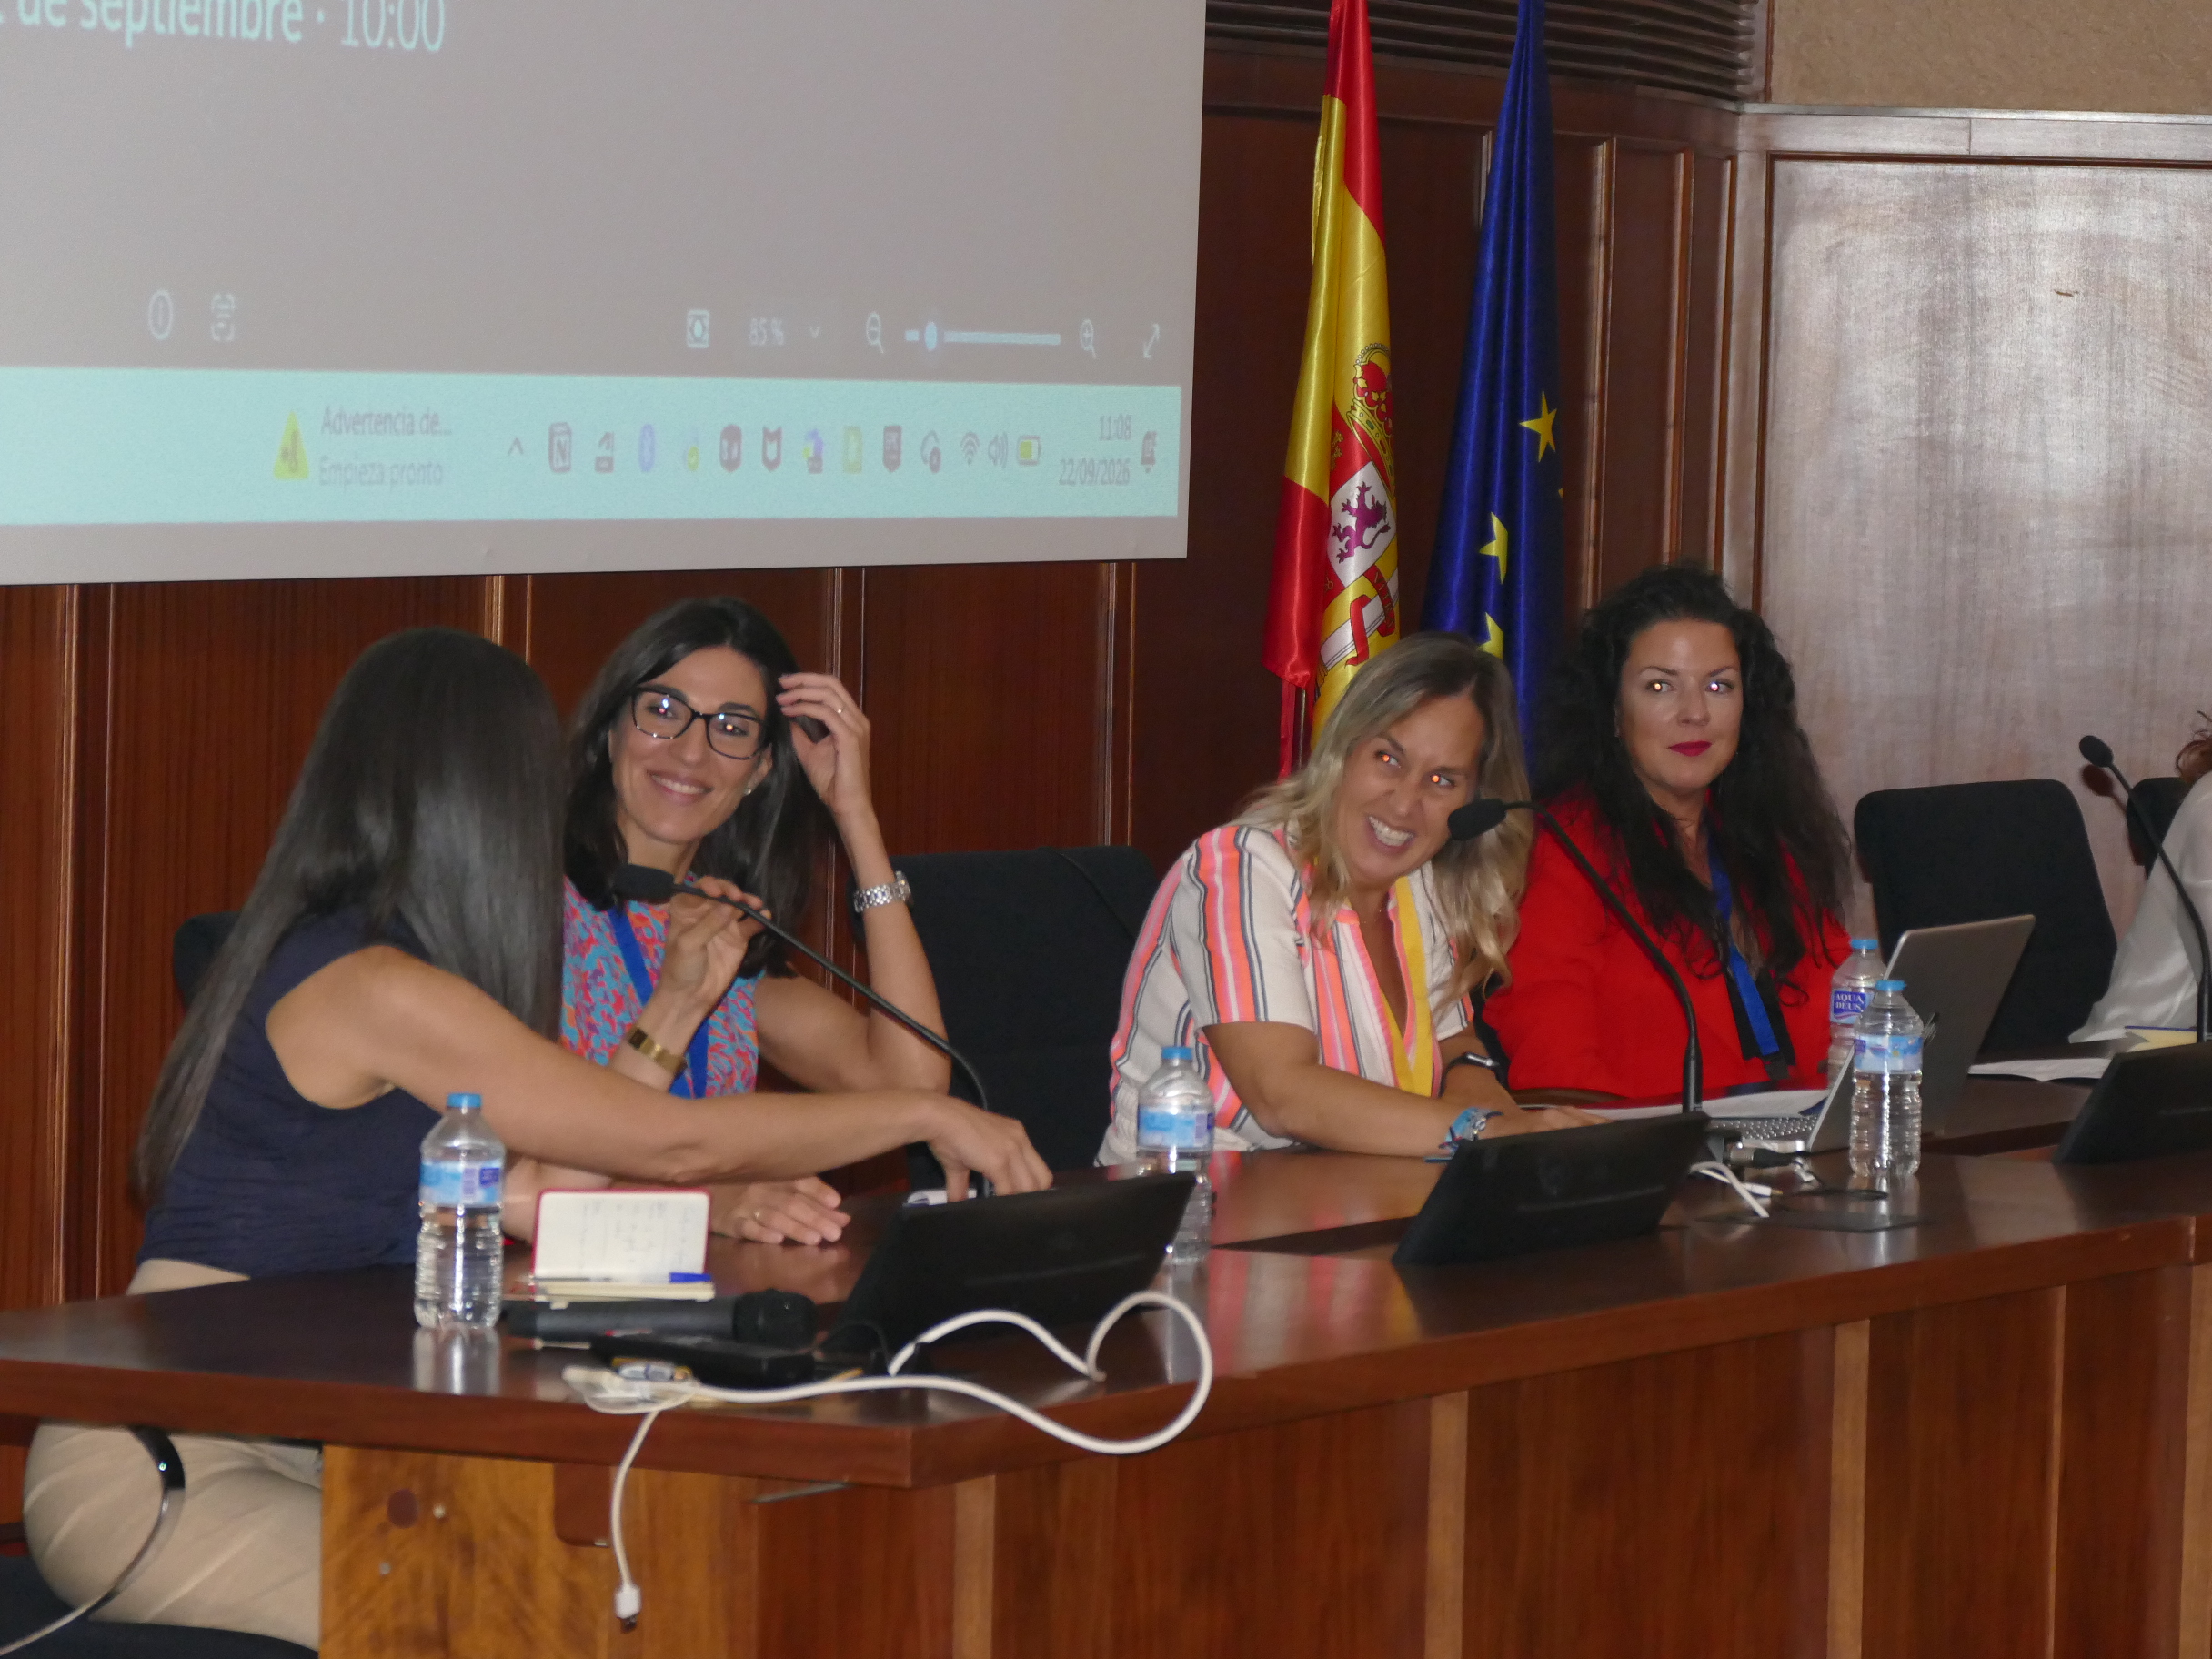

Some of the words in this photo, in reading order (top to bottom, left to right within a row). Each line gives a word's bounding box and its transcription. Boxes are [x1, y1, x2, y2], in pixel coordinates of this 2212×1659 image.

[80, 0, 305, 49] septiembre
[340, 0, 446, 52] 10:00
[320, 405, 416, 436] Advertencia
[1099, 413, 1132, 441] 11:08
[319, 454, 385, 492] Empieza
[389, 461, 444, 492] pronto
[1835, 993, 1864, 1004] AQUA
[1835, 1001, 1862, 1011] DEUS
